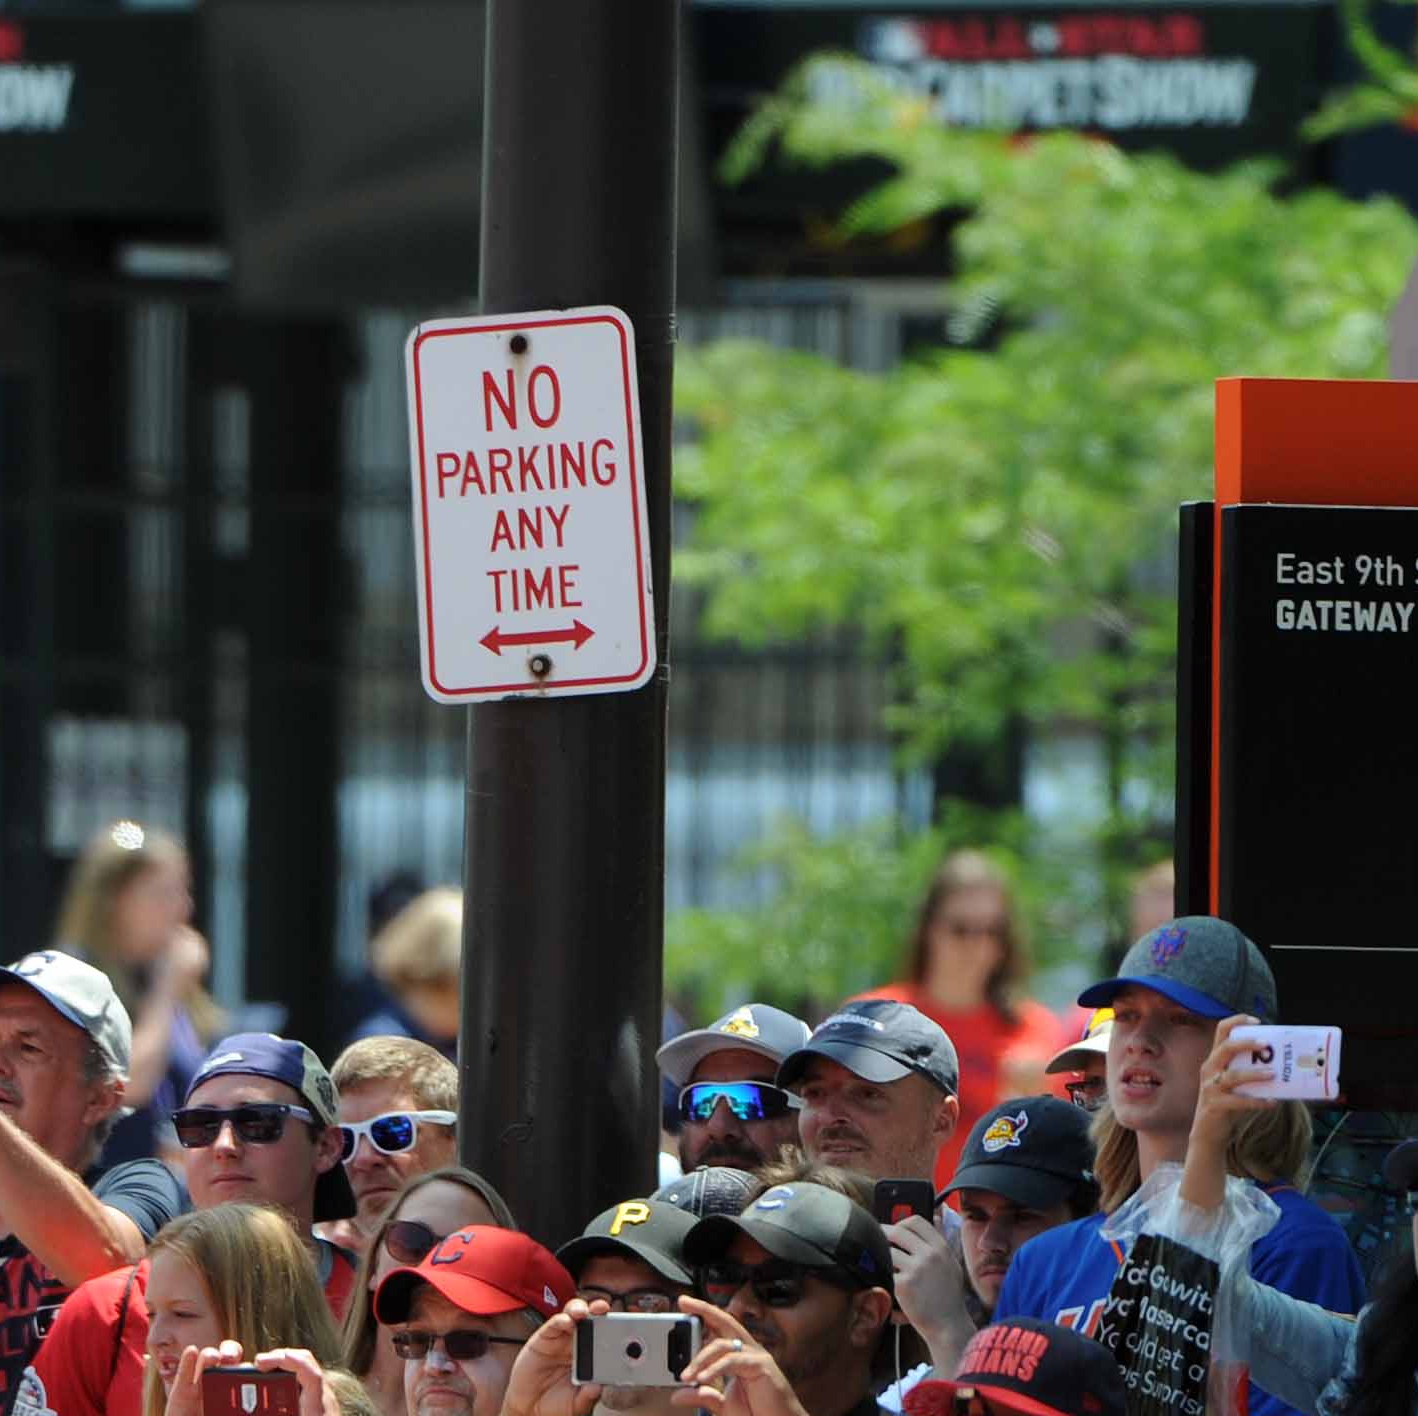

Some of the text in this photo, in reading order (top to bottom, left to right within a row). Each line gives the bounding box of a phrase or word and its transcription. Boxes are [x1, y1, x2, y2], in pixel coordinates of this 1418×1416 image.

[482, 364, 561, 432] NO
[436, 439, 618, 498] PARKING
[490, 504, 571, 552] ANY
[486, 565, 583, 613] TIME
[1276, 553, 1345, 585] East
[1355, 555, 1405, 586] 9th
[1276, 600, 1415, 632] GATEWAY
[609, 1200, 652, 1236] P
[432, 1229, 476, 1266] C
